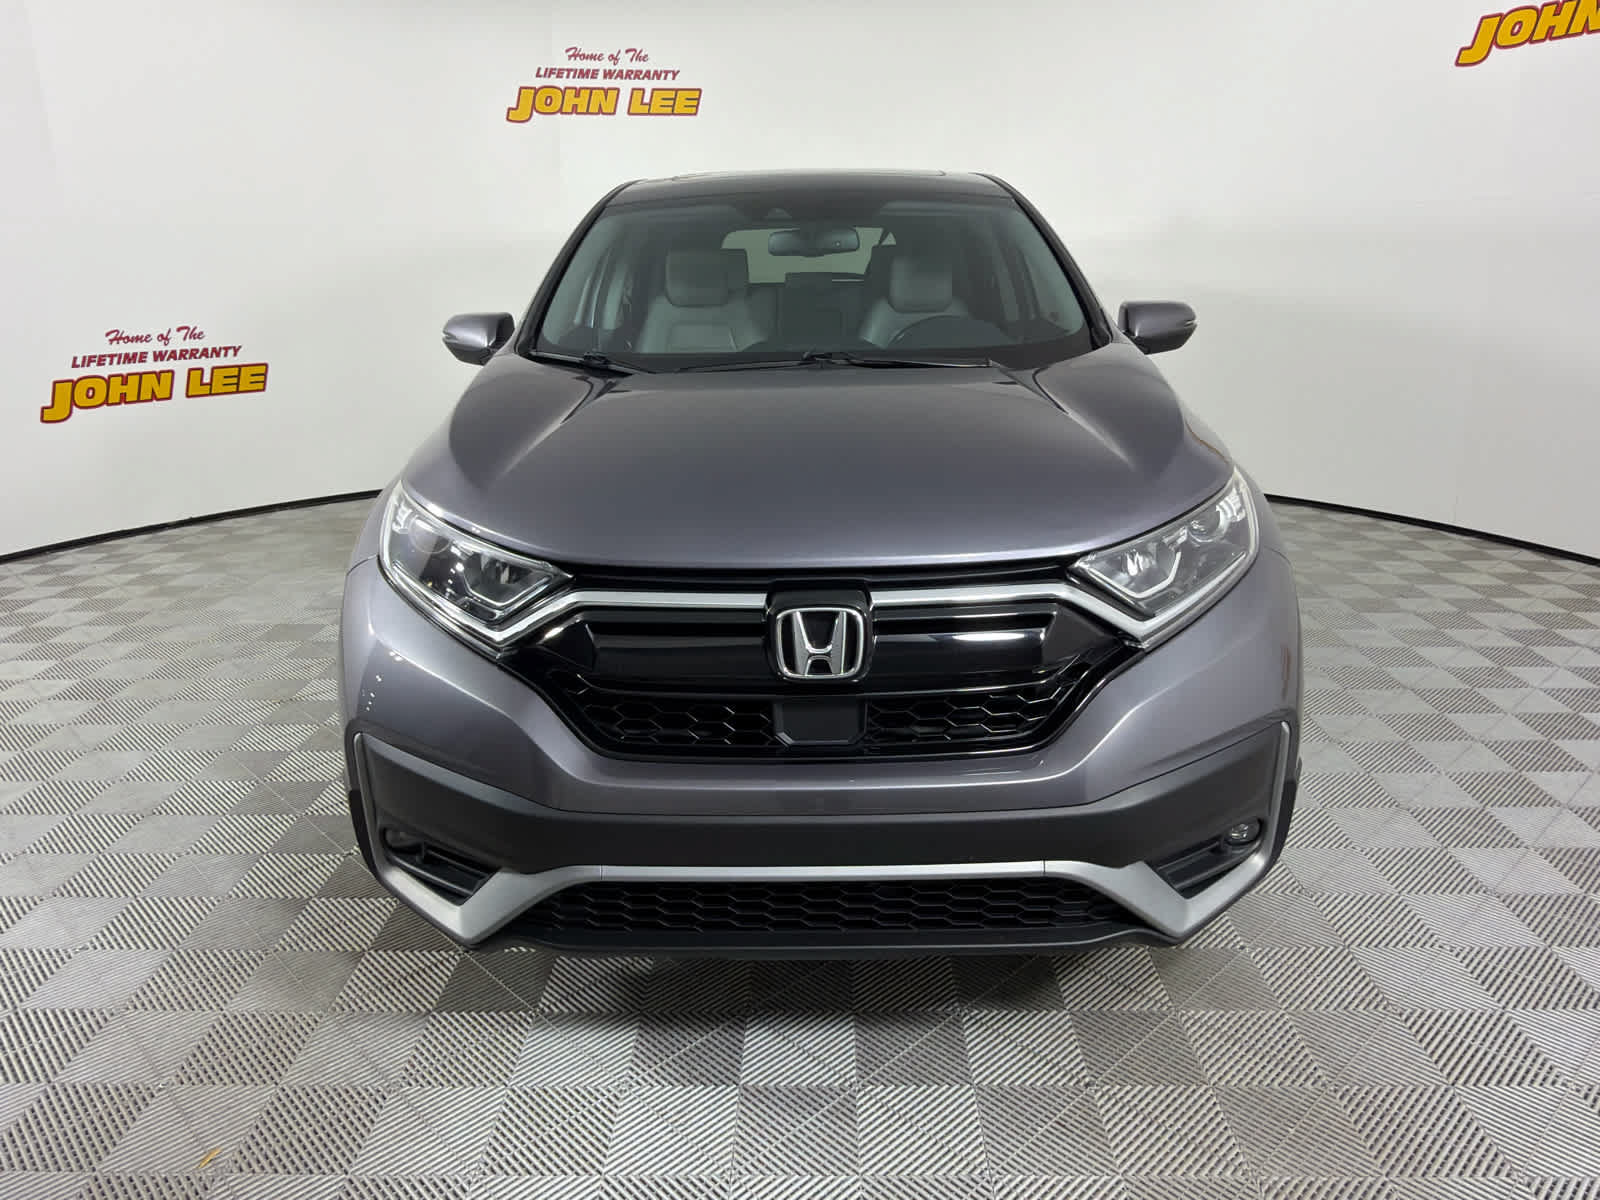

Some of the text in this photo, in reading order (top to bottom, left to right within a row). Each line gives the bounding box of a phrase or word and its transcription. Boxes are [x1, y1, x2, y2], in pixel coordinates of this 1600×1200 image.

[565, 47, 648, 65] Home of The
[536, 67, 680, 80] LIFETIME WARRANTY
[506, 85, 702, 123] JOHN LEE
[105, 326, 205, 346] Home of The
[71, 345, 242, 368] LIFETIME WARRANTY
[40, 363, 268, 424] JOHN LEE
